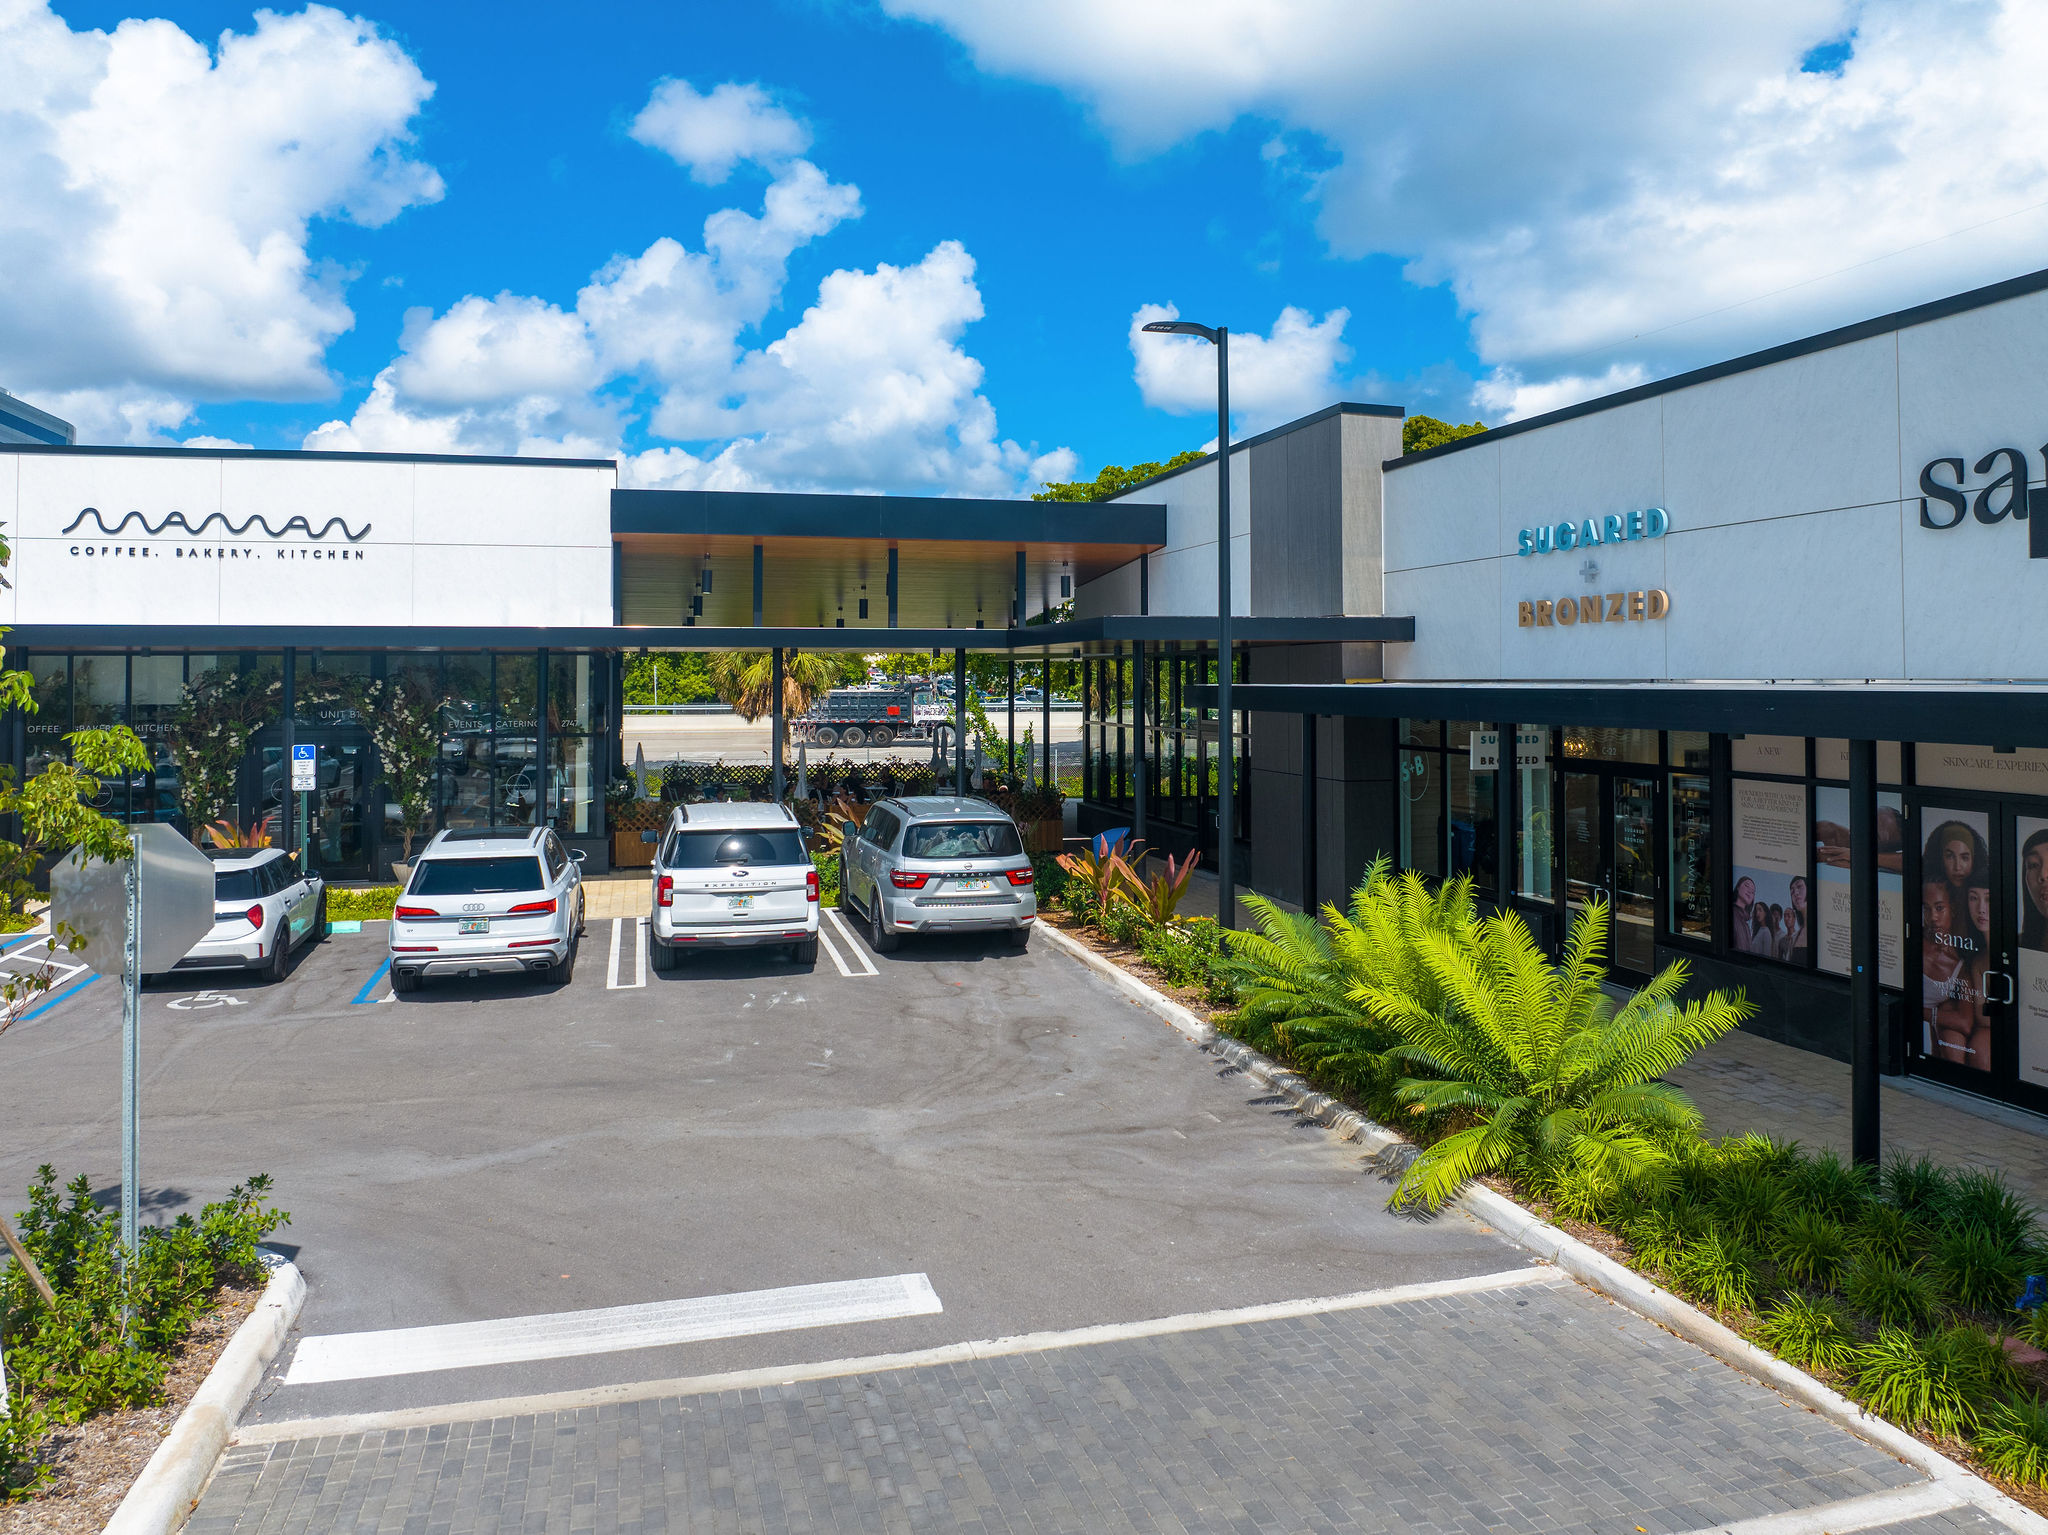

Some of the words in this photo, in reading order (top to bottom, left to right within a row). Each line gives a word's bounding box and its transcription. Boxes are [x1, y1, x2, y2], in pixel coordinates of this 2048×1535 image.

[1517, 507, 1670, 558] SUGARED
[70, 546, 160, 558] COFFEE,
[176, 548, 262, 560] BAKERY,
[277, 549, 366, 561] KITCHEN
[1517, 588, 1670, 629] BRONZED
[320, 710, 345, 719] UNIT
[27, 725, 60, 733] OFFEE
[80, 724, 114, 732] BAKER
[448, 720, 483, 729] EVENTS
[1480, 735, 1539, 745] SURED
[1764, 746, 1782, 756] NEW
[1480, 756, 1538, 765] BRZED
[1943, 756, 1994, 769] SKINCARE
[1687, 839, 1696, 911] FLAWLESS
[1934, 932, 1979, 952] sana.
